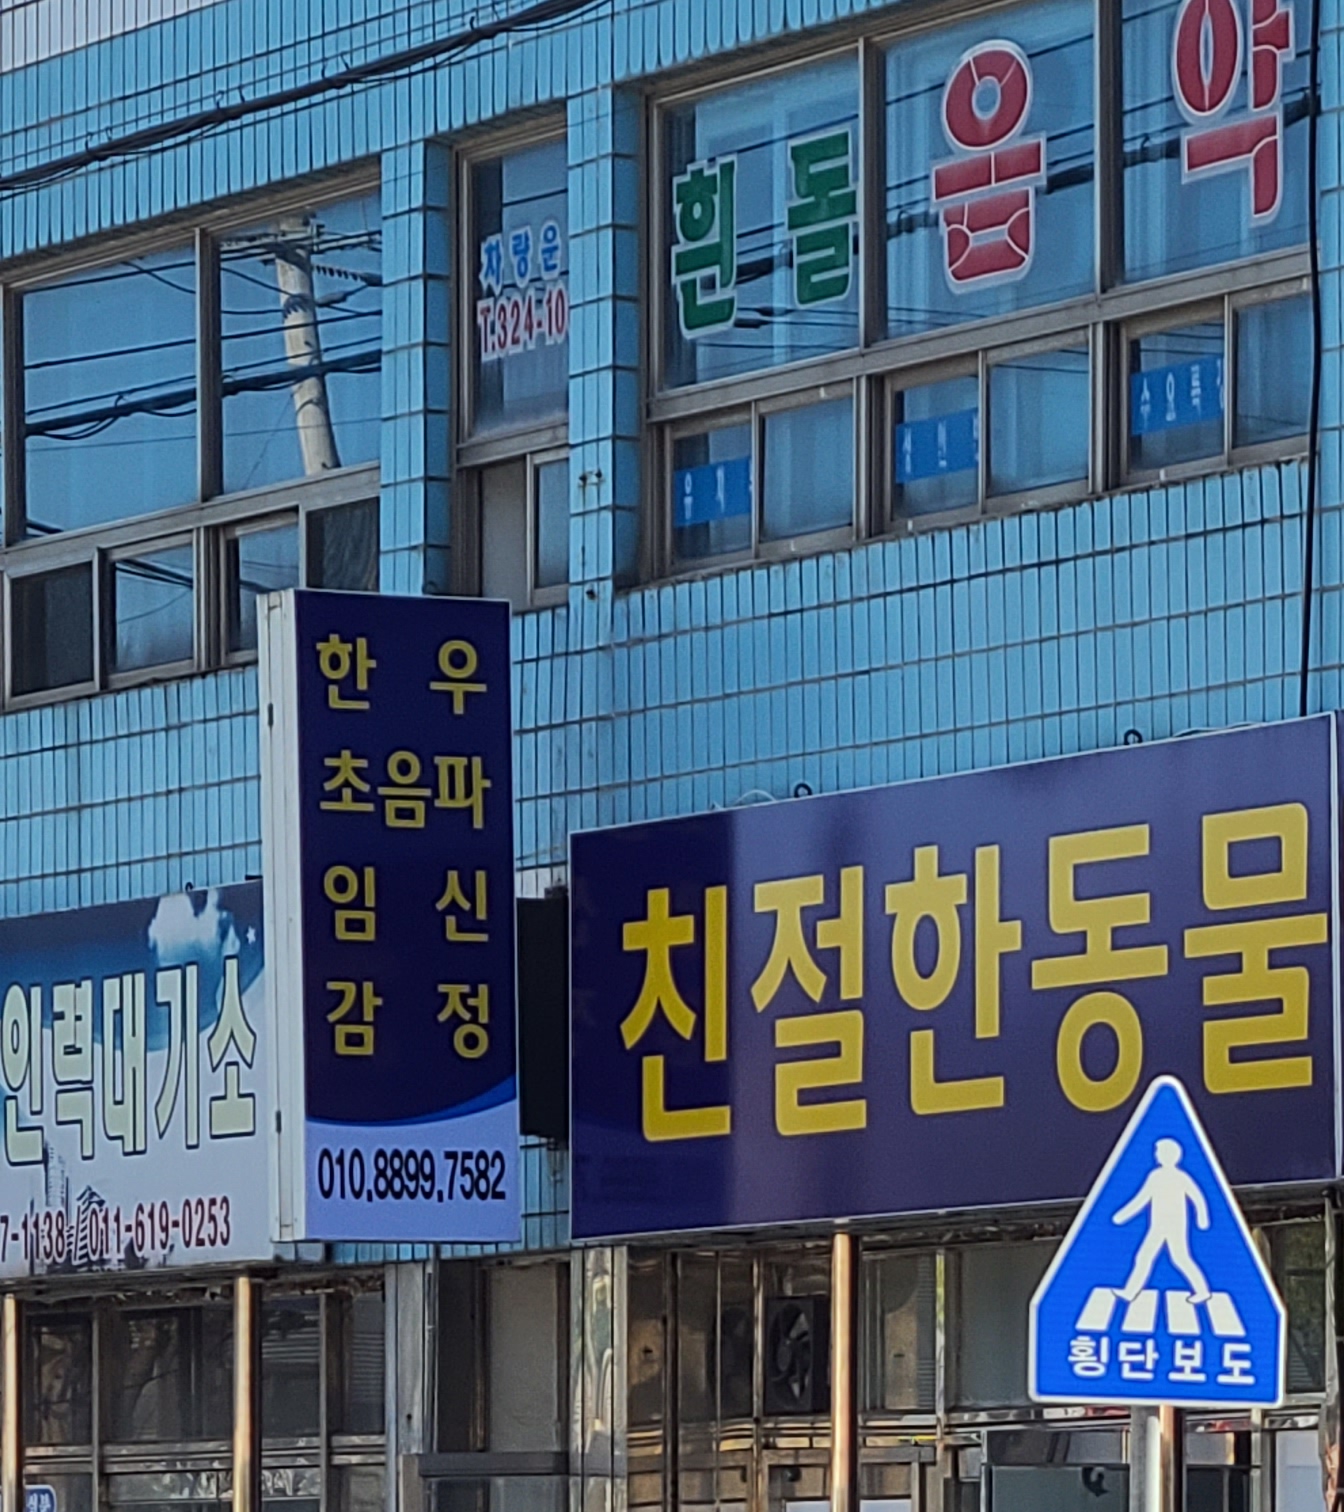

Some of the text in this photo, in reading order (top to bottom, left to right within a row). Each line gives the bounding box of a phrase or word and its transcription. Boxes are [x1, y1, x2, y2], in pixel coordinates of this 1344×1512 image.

[315, 633, 487, 714] 한우
[320, 749, 491, 829] 초음파
[323, 865, 489, 942] 임신
[326, 981, 490, 1060] 감정
[1, 956, 258, 1166] 인력대기소
[318, 1148, 506, 1202] 010.8899.7582
[1067, 1335, 1256, 1385] 횡단보도
